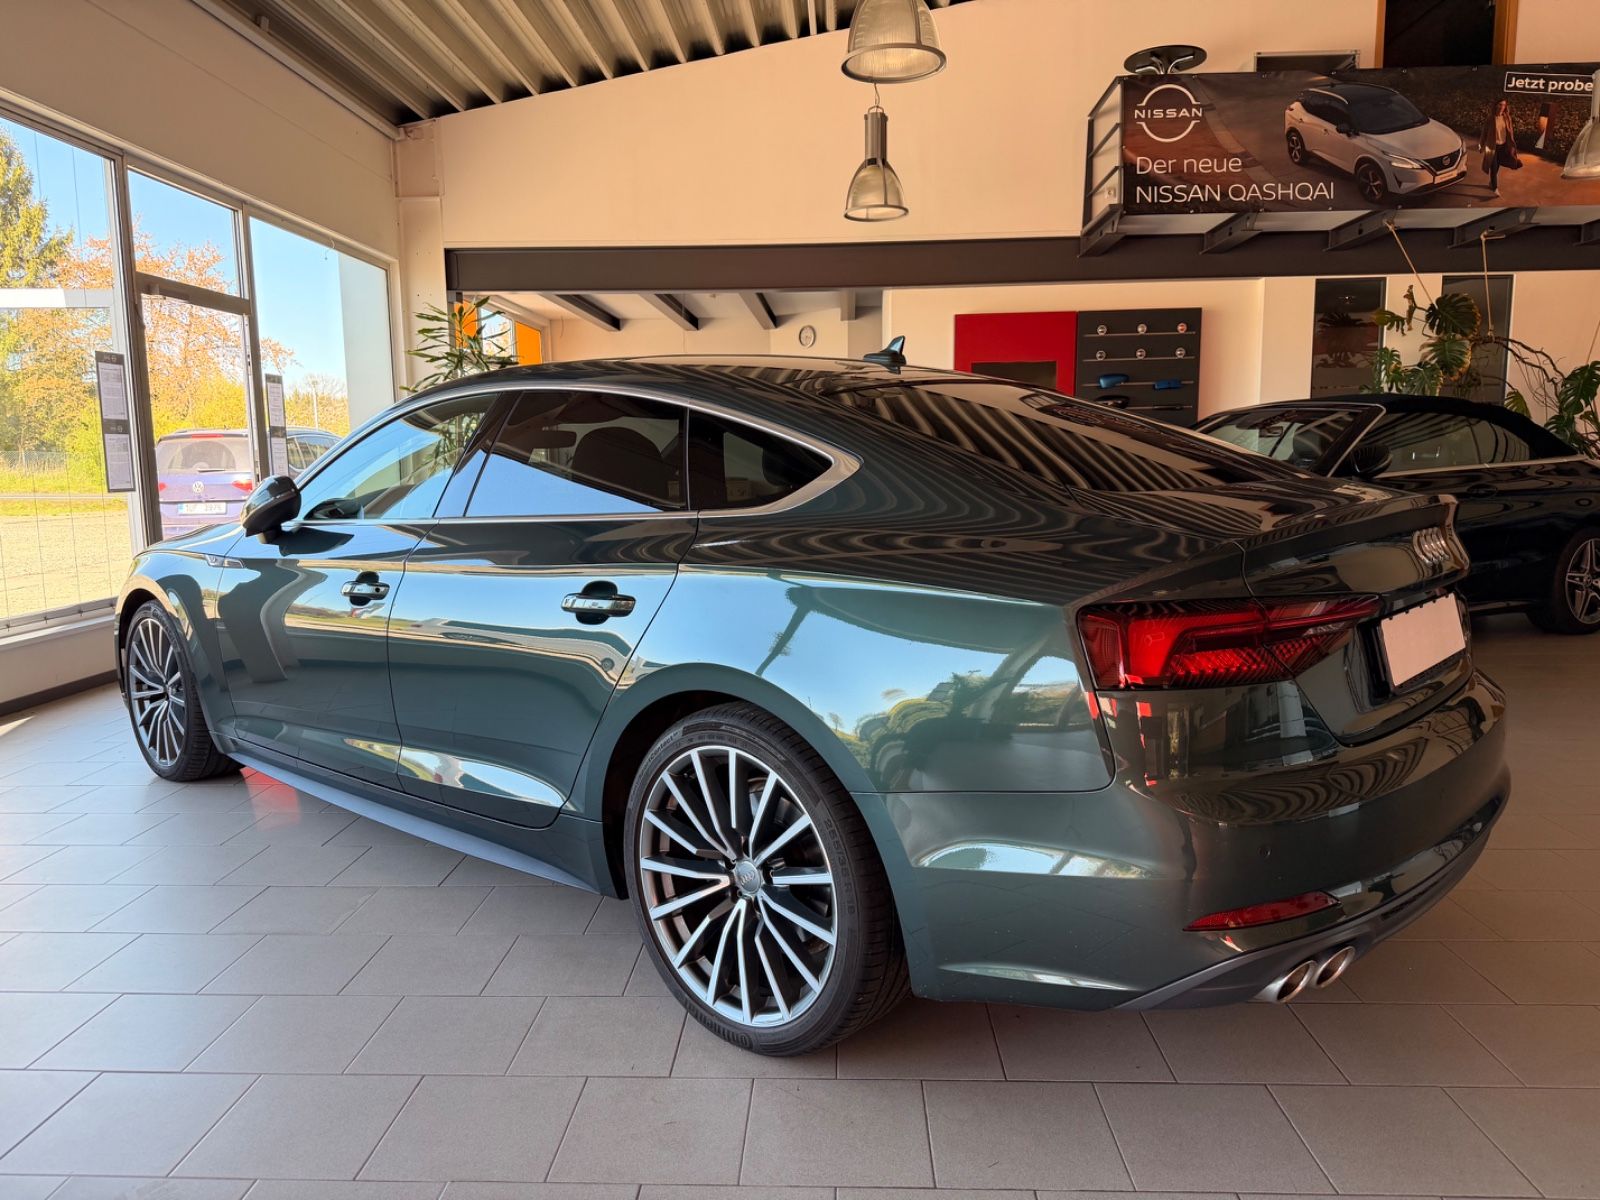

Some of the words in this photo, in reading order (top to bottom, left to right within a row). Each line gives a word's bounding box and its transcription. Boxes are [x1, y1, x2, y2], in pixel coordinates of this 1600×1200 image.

[1507, 77, 1545, 89] Jetzt
[1134, 107, 1203, 119] NISSAN
[1136, 156, 1177, 175] Der
[1183, 156, 1243, 174] neue
[1136, 184, 1221, 204] NISSAN
[1228, 181, 1334, 202] QASHQAI
